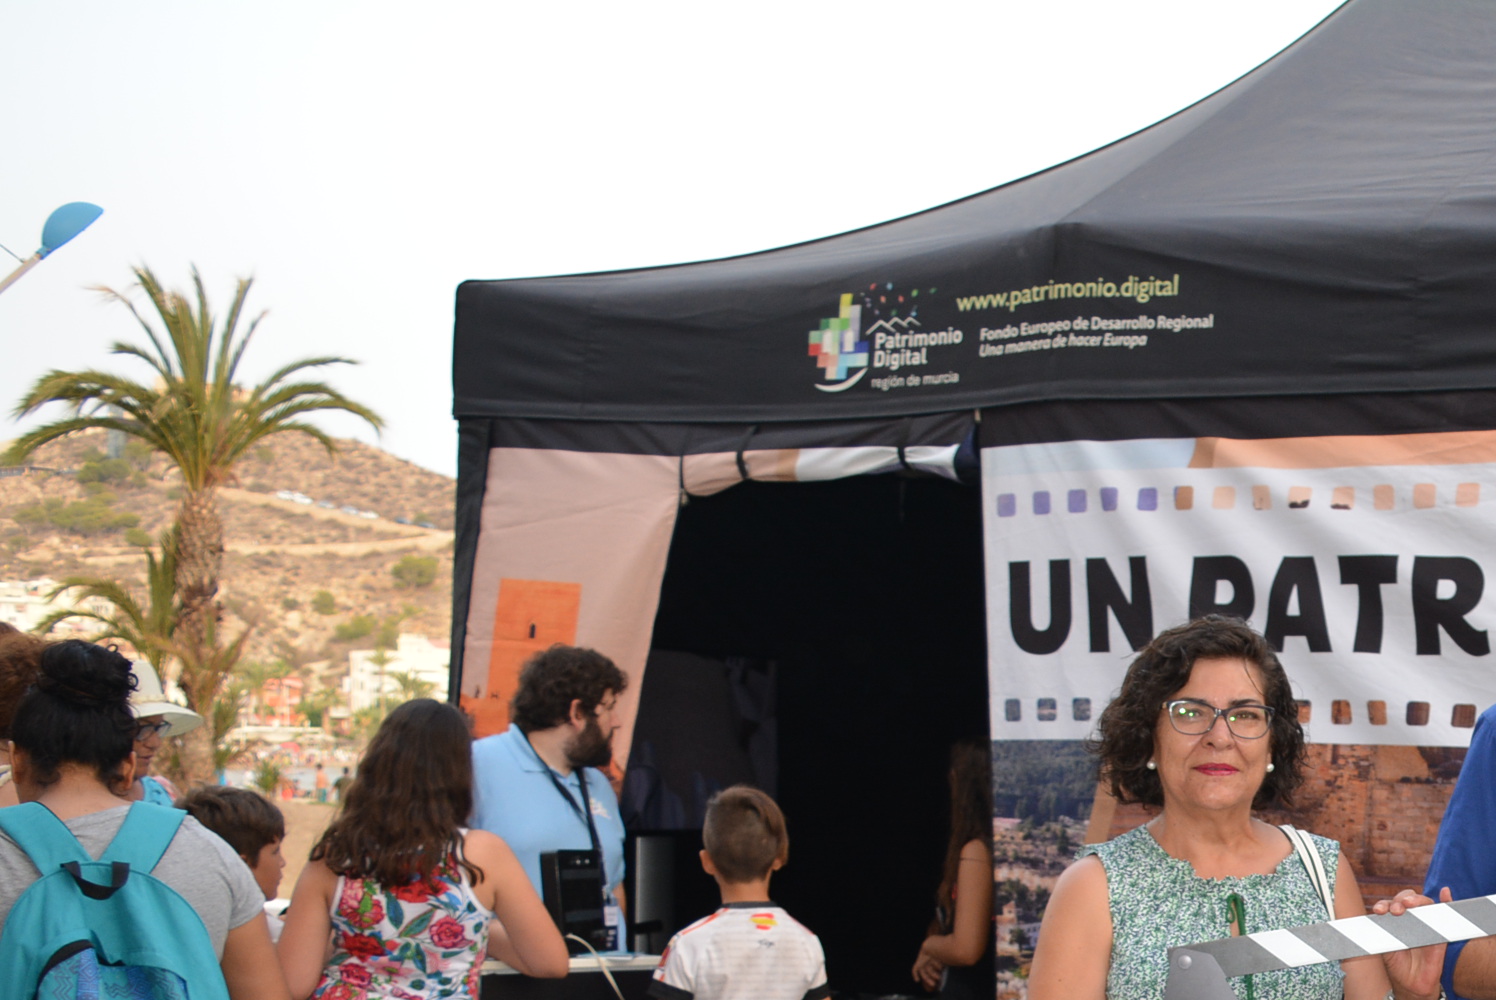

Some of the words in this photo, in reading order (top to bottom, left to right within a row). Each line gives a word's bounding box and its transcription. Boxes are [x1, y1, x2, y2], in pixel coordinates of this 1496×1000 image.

[956, 274, 1180, 312] www.patrimonio.digital
[874, 326, 963, 350] Patrimonio
[980, 324, 1019, 341] Fondo
[1020, 318, 1071, 336] Europeo
[1072, 315, 1090, 331] de
[1091, 314, 1155, 331] Desarrollo
[1156, 313, 1215, 333] Regional
[978, 342, 1004, 358] Una
[1004, 337, 1051, 354] manera
[1052, 333, 1068, 348] de
[1068, 332, 1102, 347] hacer
[1103, 332, 1148, 349] Europa
[873, 347, 928, 371] Digital
[871, 374, 905, 391] región
[906, 373, 921, 387] de
[922, 370, 960, 385] murcia
[1008, 555, 1155, 656] UN
